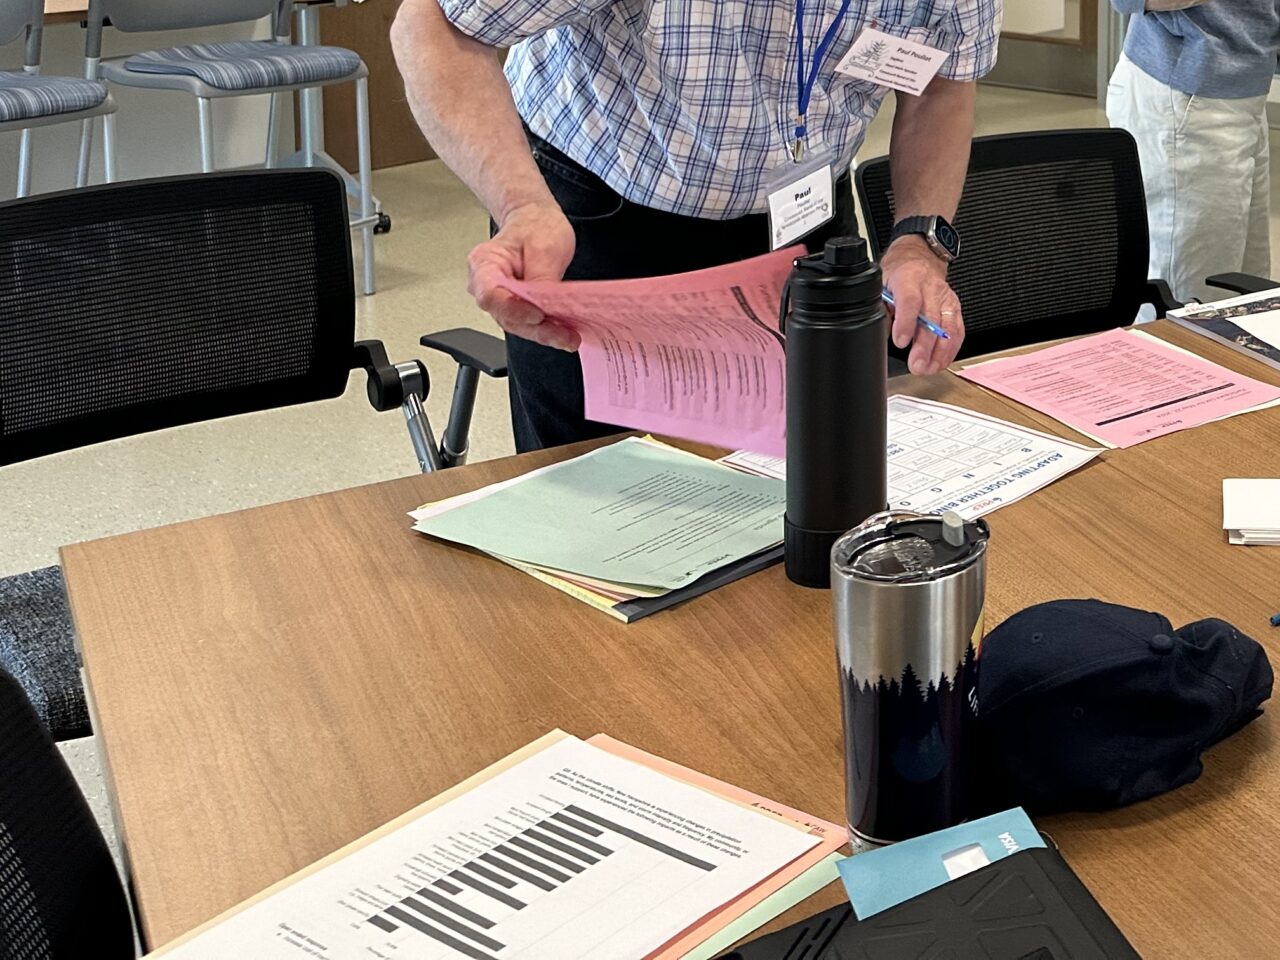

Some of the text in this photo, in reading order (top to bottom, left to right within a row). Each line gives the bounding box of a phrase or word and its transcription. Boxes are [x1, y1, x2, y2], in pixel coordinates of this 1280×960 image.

[795, 187, 811, 201] Paul
[1017, 453, 1063, 479] ADAPTING
[955, 475, 1016, 503] TOGETHER
